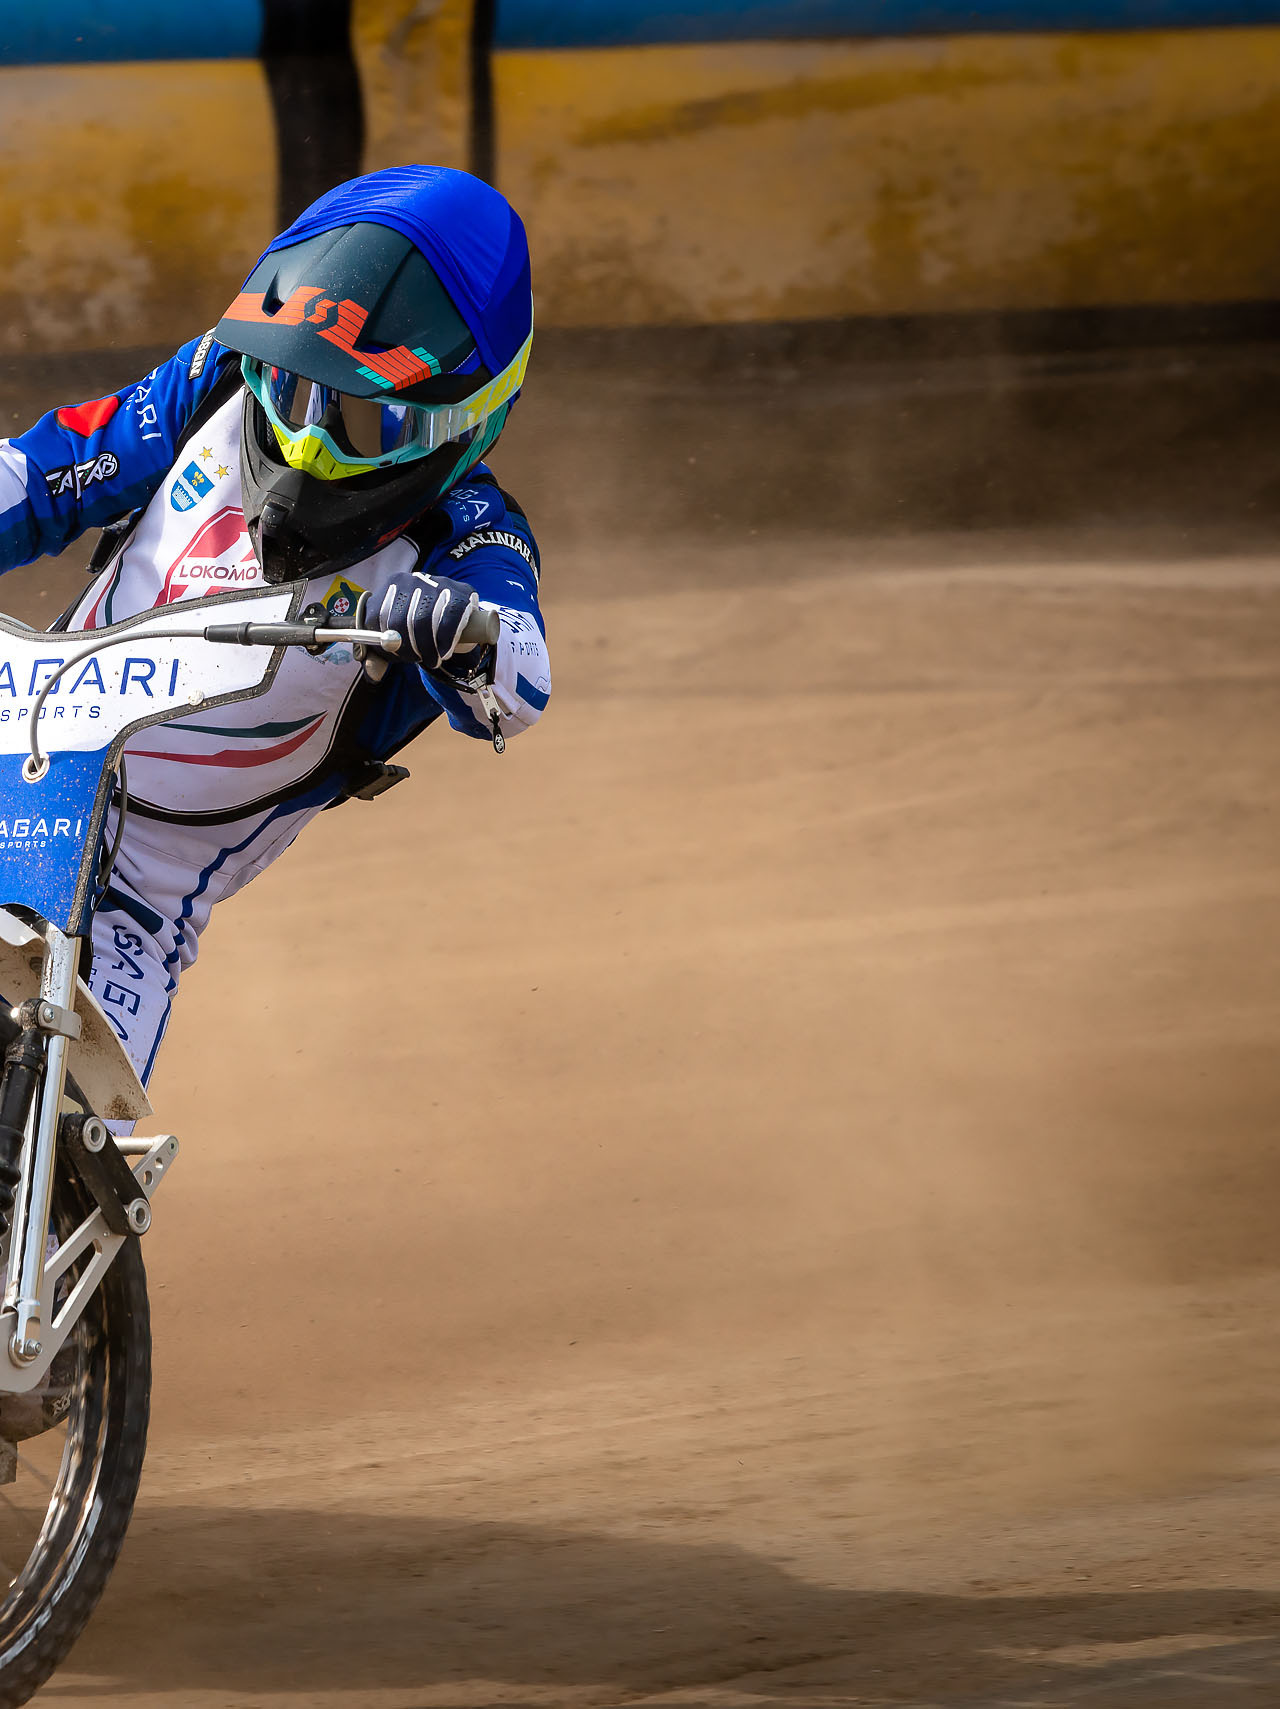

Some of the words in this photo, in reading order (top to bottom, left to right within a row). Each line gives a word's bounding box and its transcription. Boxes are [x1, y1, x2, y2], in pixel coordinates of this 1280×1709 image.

[179, 565, 260, 581] LOKOMO
[0, 705, 101, 722] SPORTS
[0, 840, 47, 849] SPORTS
